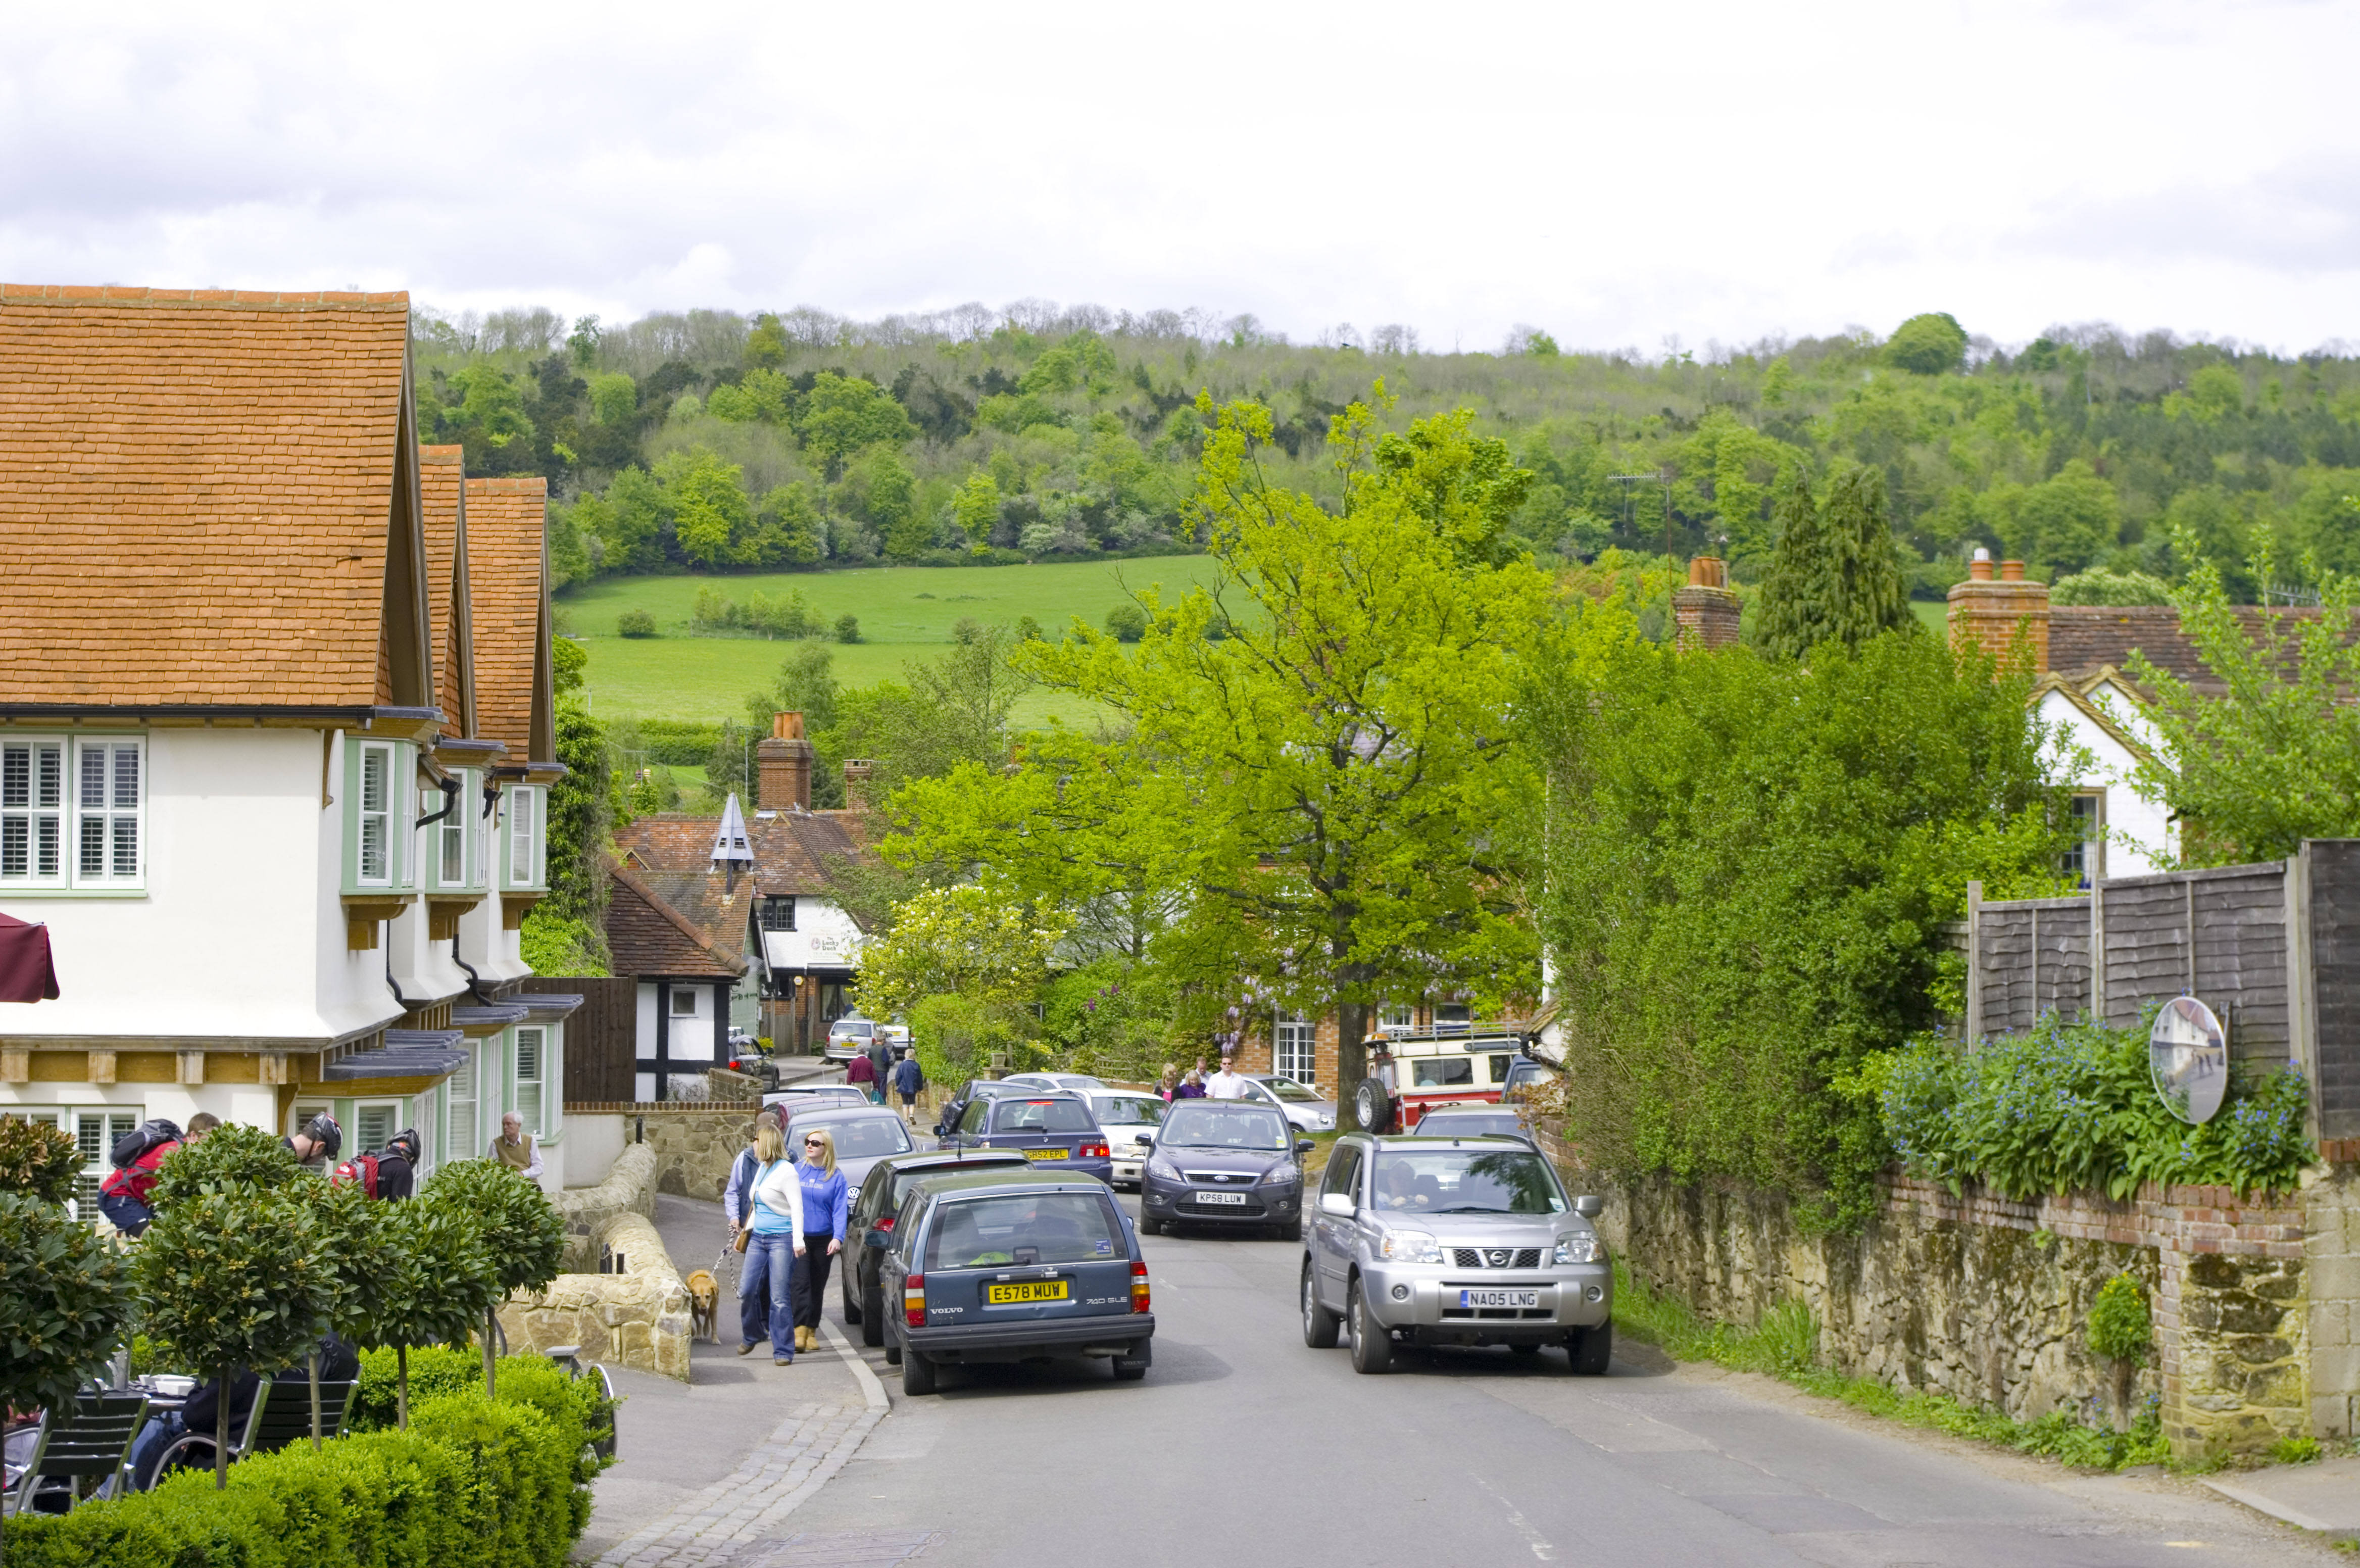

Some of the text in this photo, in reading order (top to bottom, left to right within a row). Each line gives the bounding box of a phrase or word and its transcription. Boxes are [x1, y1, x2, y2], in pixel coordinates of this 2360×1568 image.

[1050, 1150, 1065, 1158] EPL
[1200, 1194, 1222, 1202] KP58
[994, 1284, 1060, 1300] E578 MUW
[1470, 1293, 1535, 1305] NA05 LNG
